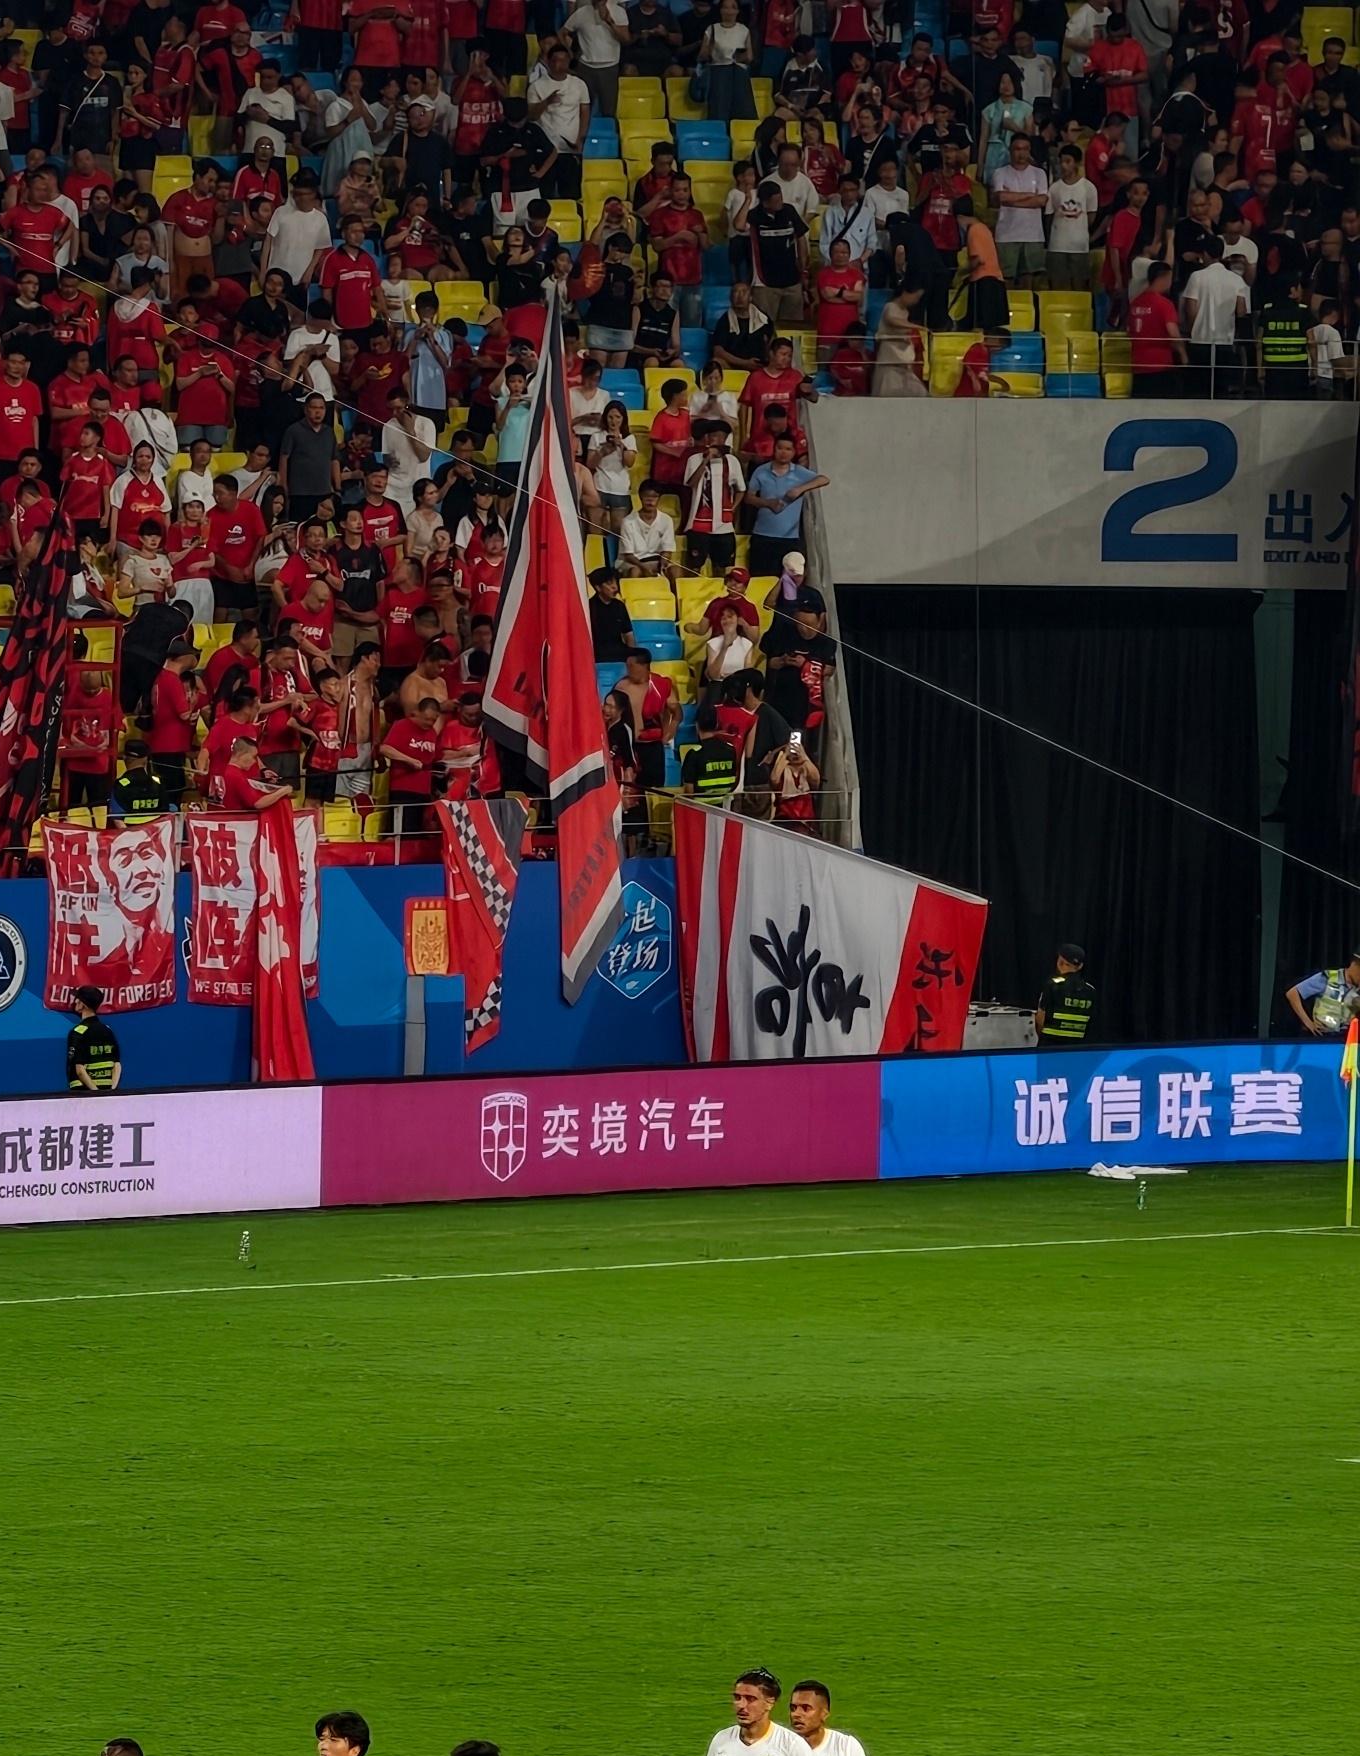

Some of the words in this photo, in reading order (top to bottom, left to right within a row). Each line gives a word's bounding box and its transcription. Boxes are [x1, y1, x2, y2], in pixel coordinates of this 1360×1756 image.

[1102, 418, 1238, 562] 2
[607, 936, 659, 977] 登场
[541, 1096, 724, 1159] 奕境汽车
[1014, 1070, 1304, 1146] 诚信联赛
[61, 1177, 155, 1196] CONSTRUCTION
